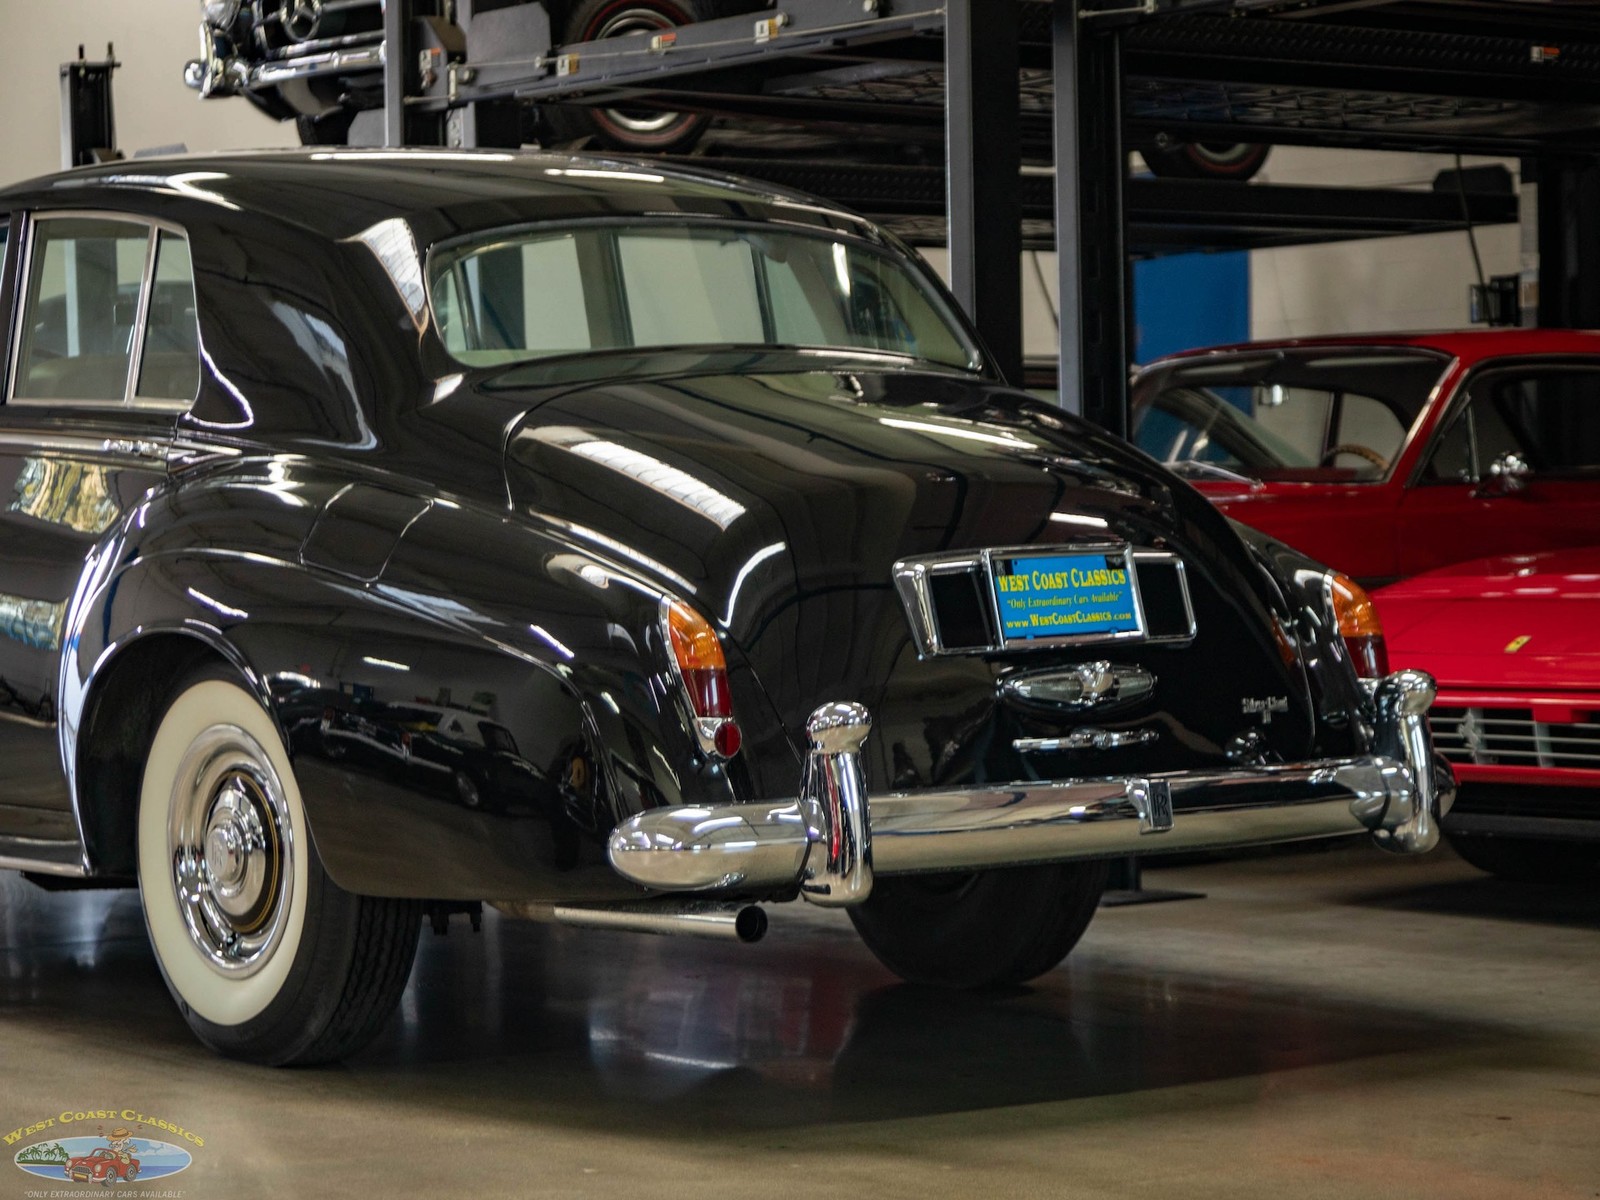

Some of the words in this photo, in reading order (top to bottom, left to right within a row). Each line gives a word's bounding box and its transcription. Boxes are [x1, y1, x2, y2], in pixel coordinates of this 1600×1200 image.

[998, 574, 1030, 593] WEST
[1032, 570, 1069, 591] COAST
[1070, 567, 1127, 588] CLASSICS
